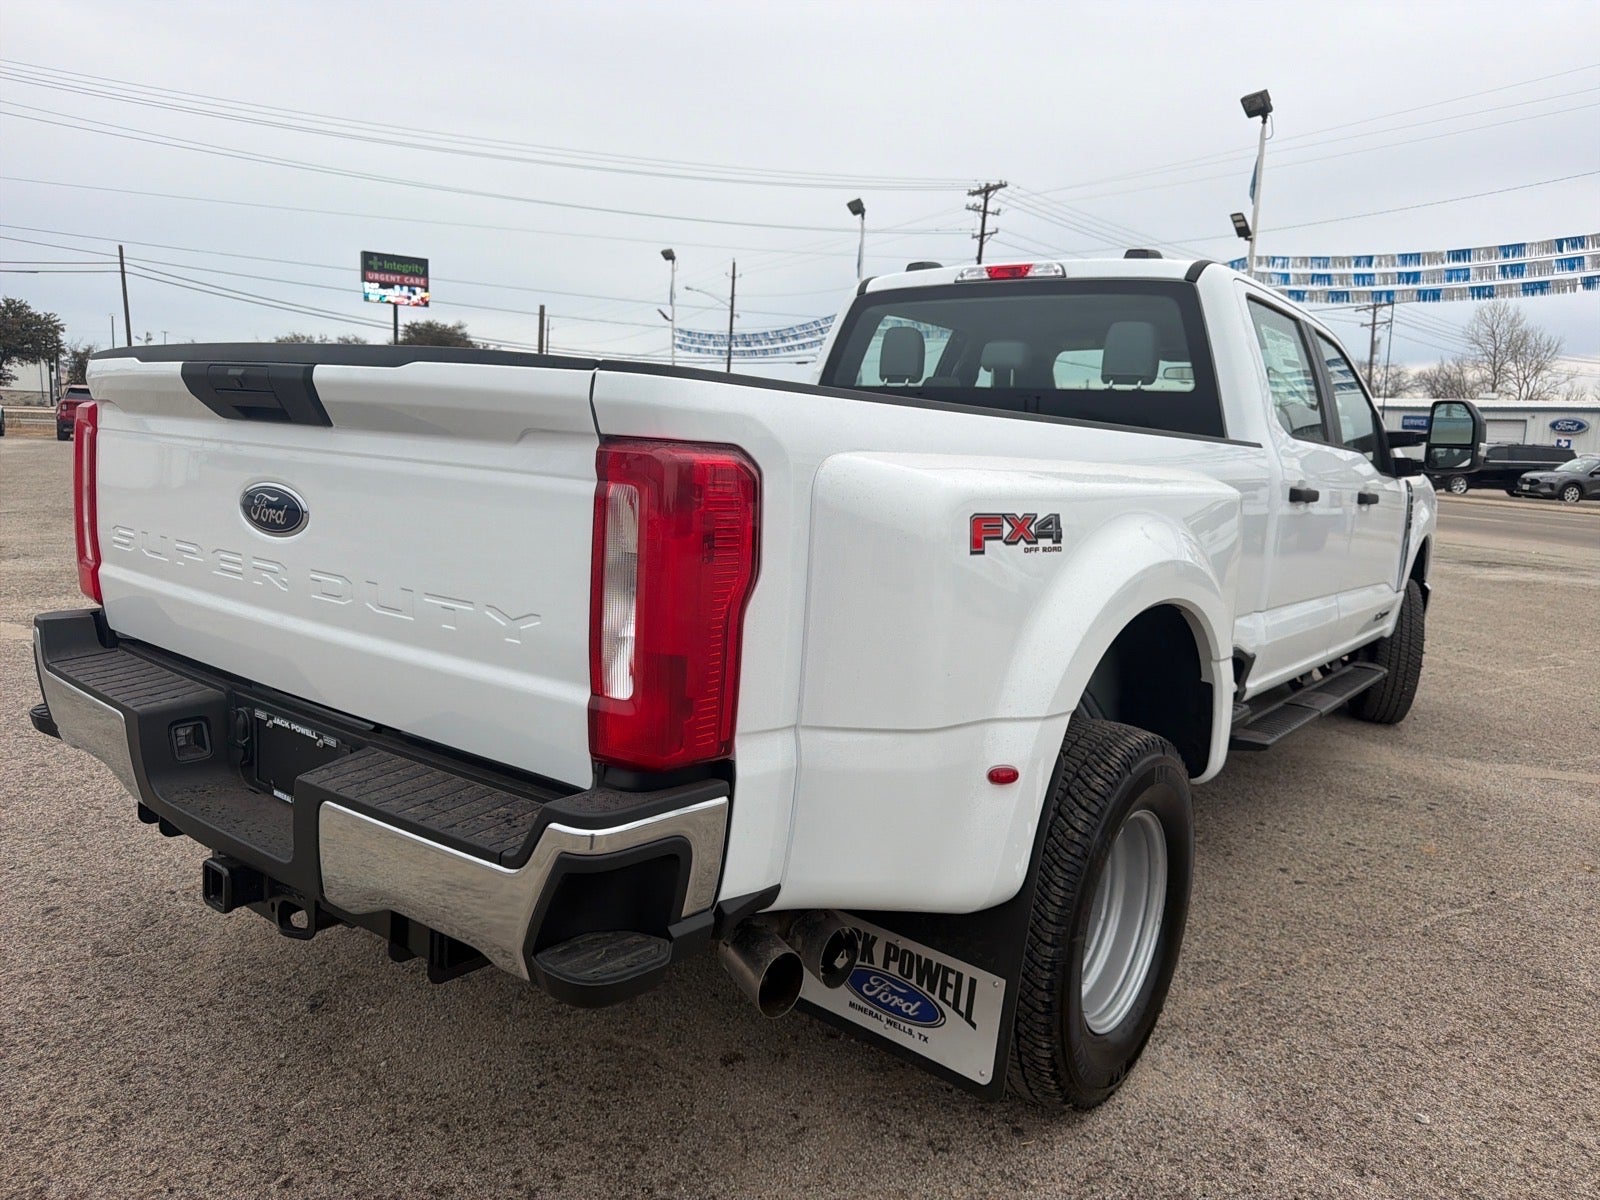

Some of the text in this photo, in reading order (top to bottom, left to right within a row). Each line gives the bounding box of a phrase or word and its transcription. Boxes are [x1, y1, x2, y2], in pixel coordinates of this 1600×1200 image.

[368, 273, 424, 285] URGENT CARE
[384, 260, 424, 274] Integrity
[1555, 421, 1580, 431] Ford
[250, 491, 287, 525] Ford
[969, 512, 1063, 555] FX4
[112, 525, 542, 645] SUPER DUTY
[273, 717, 318, 740] JACK POWELL
[862, 974, 921, 1018] Ford
[882, 941, 978, 1031] POWELL
[849, 1000, 930, 1044] MINERAL WELLS, TX
